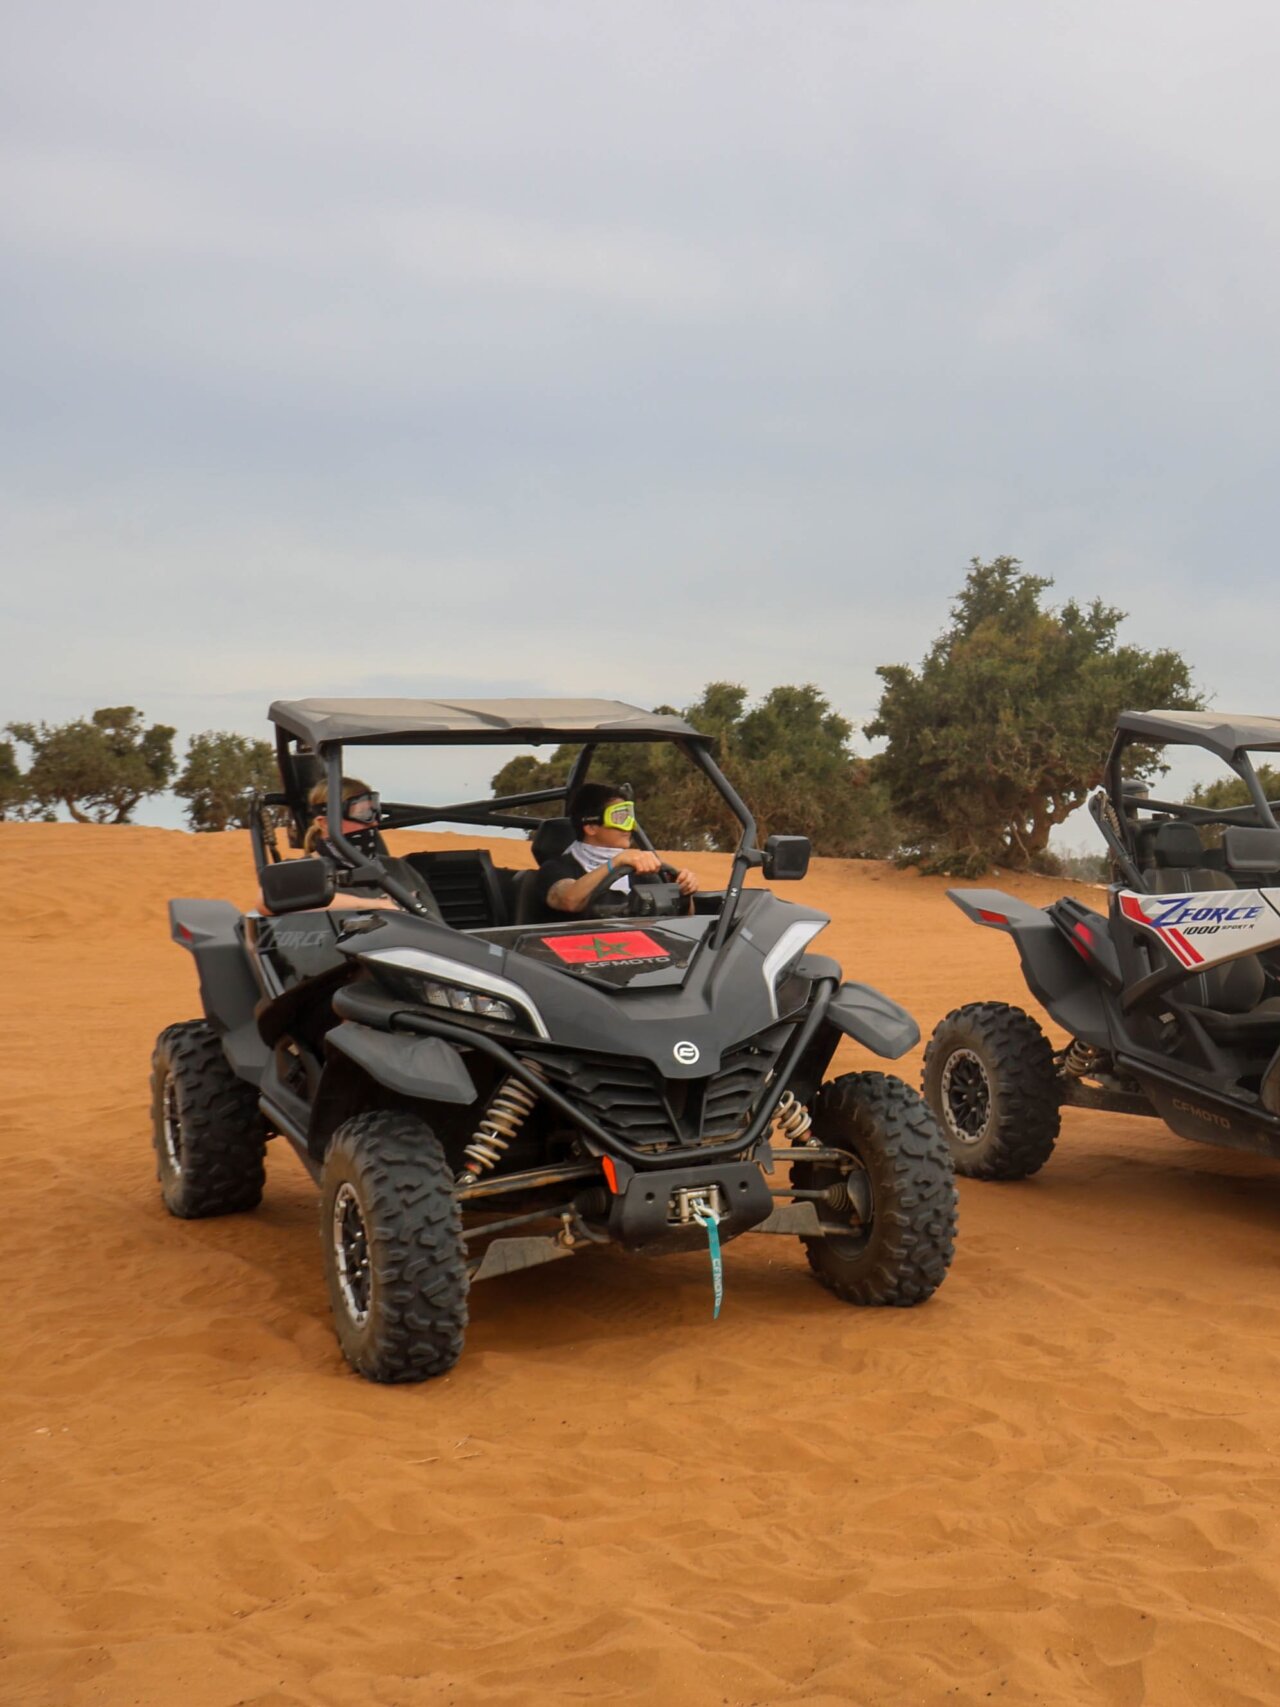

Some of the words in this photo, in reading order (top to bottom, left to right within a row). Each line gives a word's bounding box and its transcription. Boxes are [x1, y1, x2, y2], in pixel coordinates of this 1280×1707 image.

[1183, 925, 1220, 935] 1000
[584, 957, 671, 968] CFMOTO
[1172, 1098, 1231, 1129] CFMOTO
